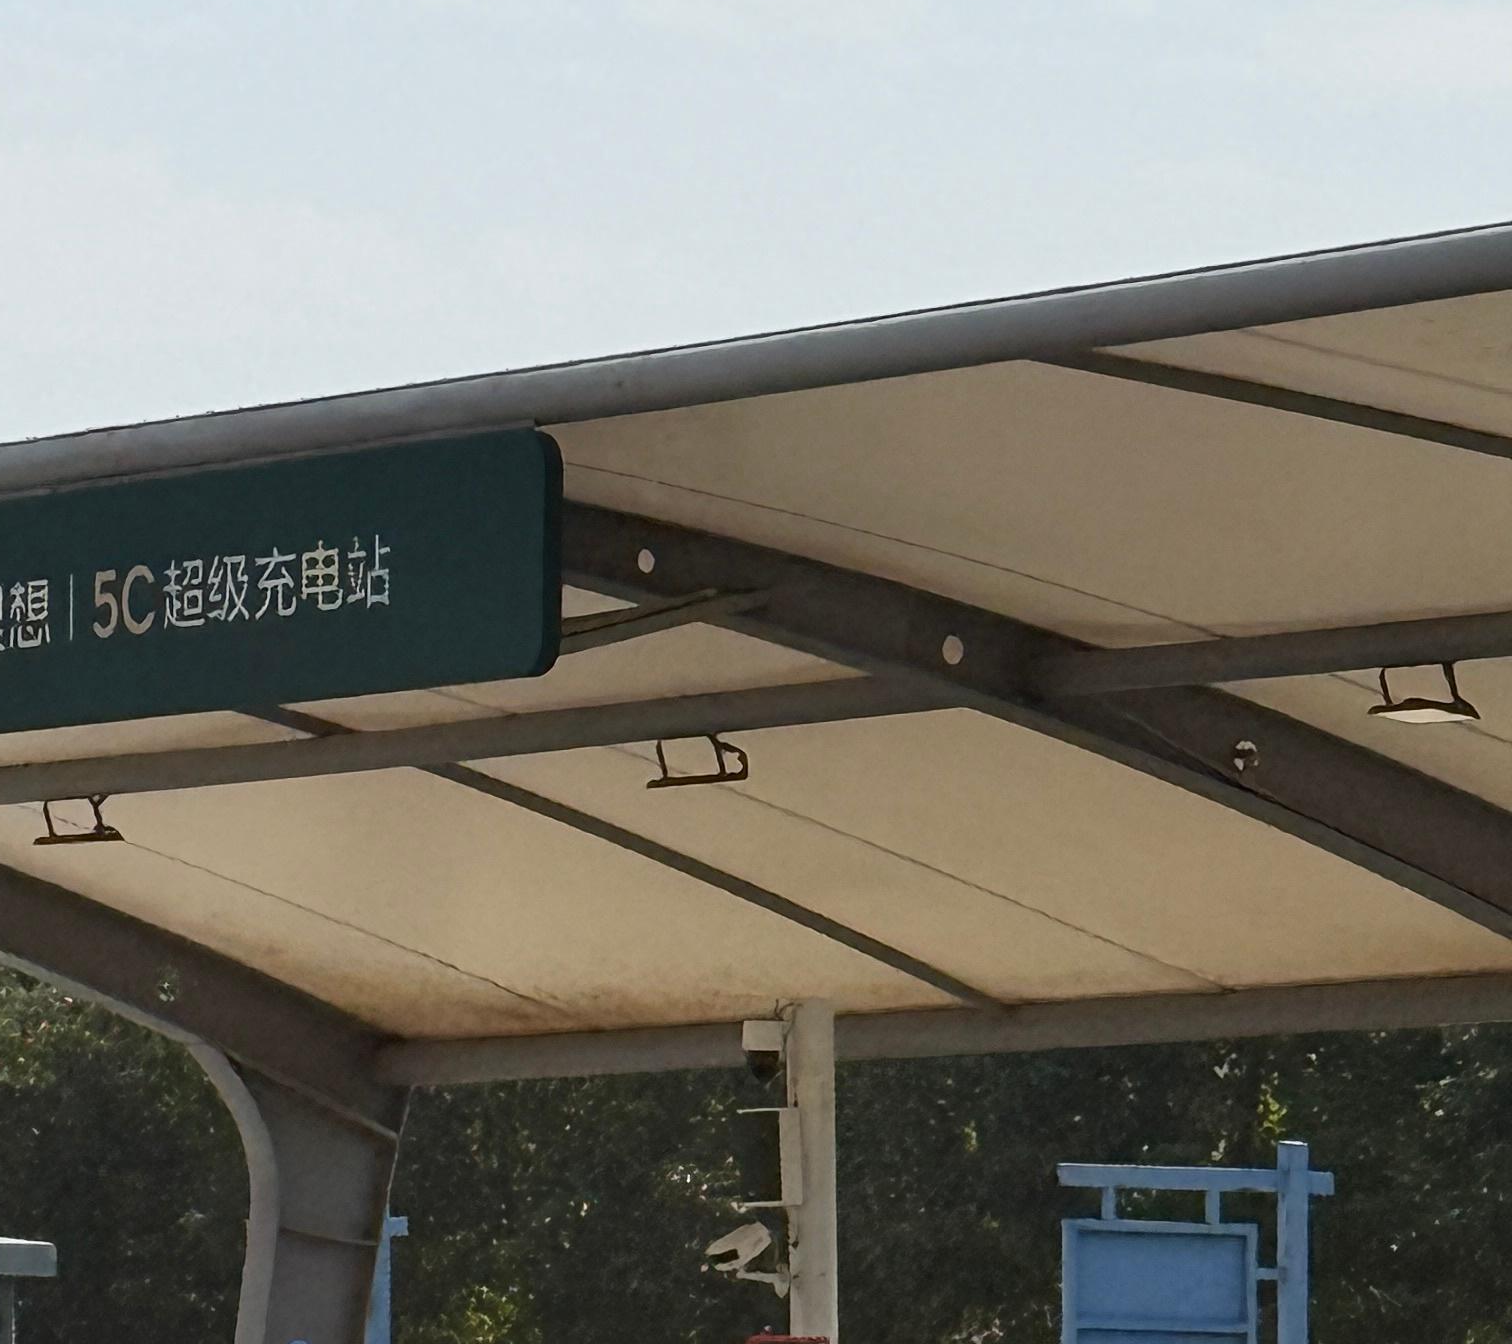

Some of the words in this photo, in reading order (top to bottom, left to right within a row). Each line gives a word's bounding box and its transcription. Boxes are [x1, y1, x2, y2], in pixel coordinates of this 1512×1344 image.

[93, 534, 391, 640] 5C超级充电站
